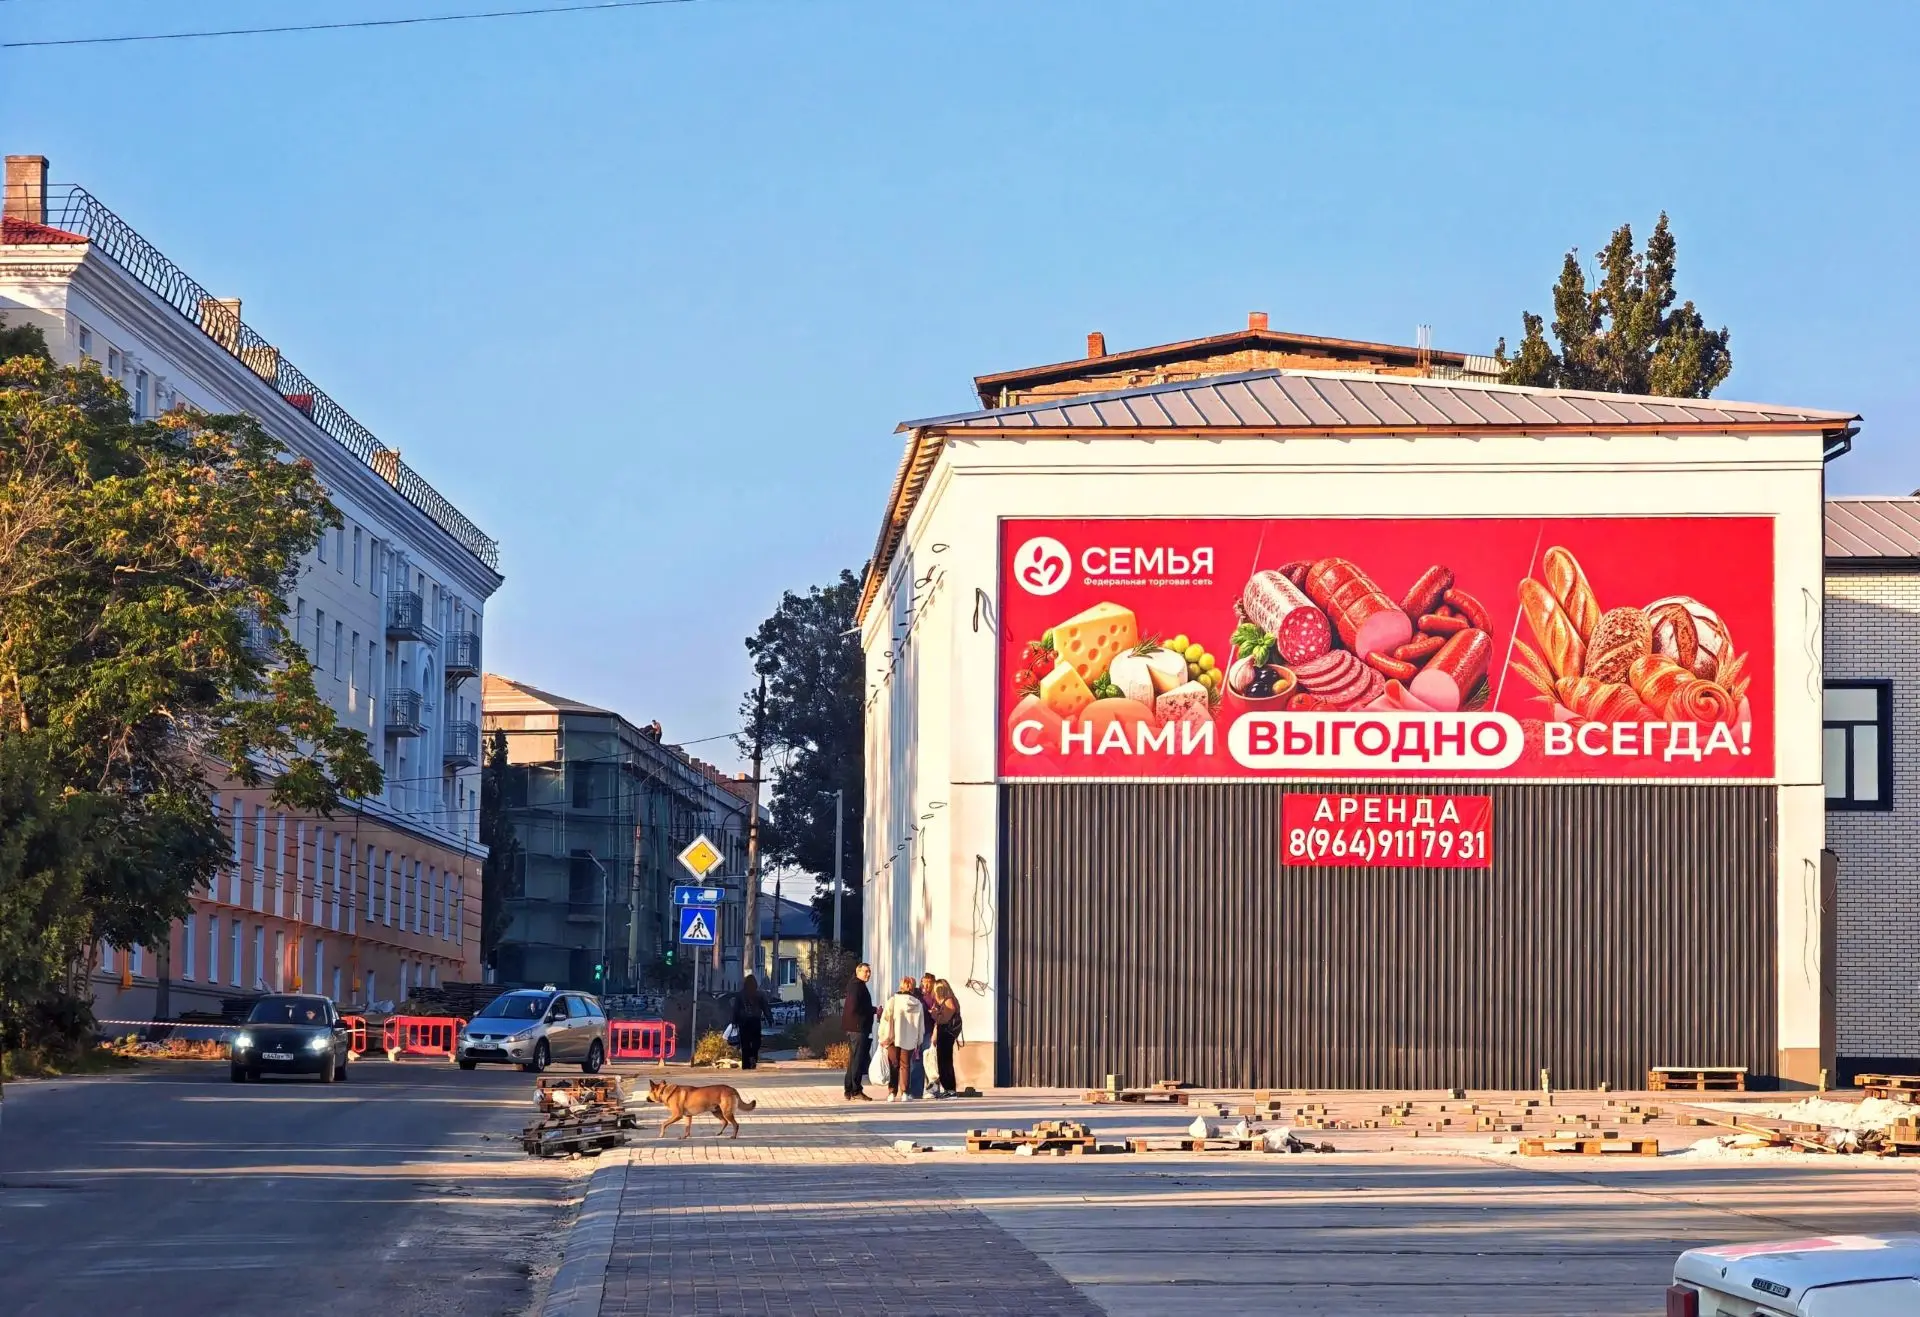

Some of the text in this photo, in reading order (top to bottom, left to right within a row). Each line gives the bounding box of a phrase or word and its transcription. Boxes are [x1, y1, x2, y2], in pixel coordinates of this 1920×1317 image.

[1081, 547, 1213, 575] СЕМЬЯ
[1083, 577, 1147, 587] Федеральная
[1149, 578, 1190, 587] торговая
[1012, 720, 1752, 762] С НАМИ ВЫГОДНО ВСЕГДА!
[1313, 797, 1460, 827] АРЕНДА
